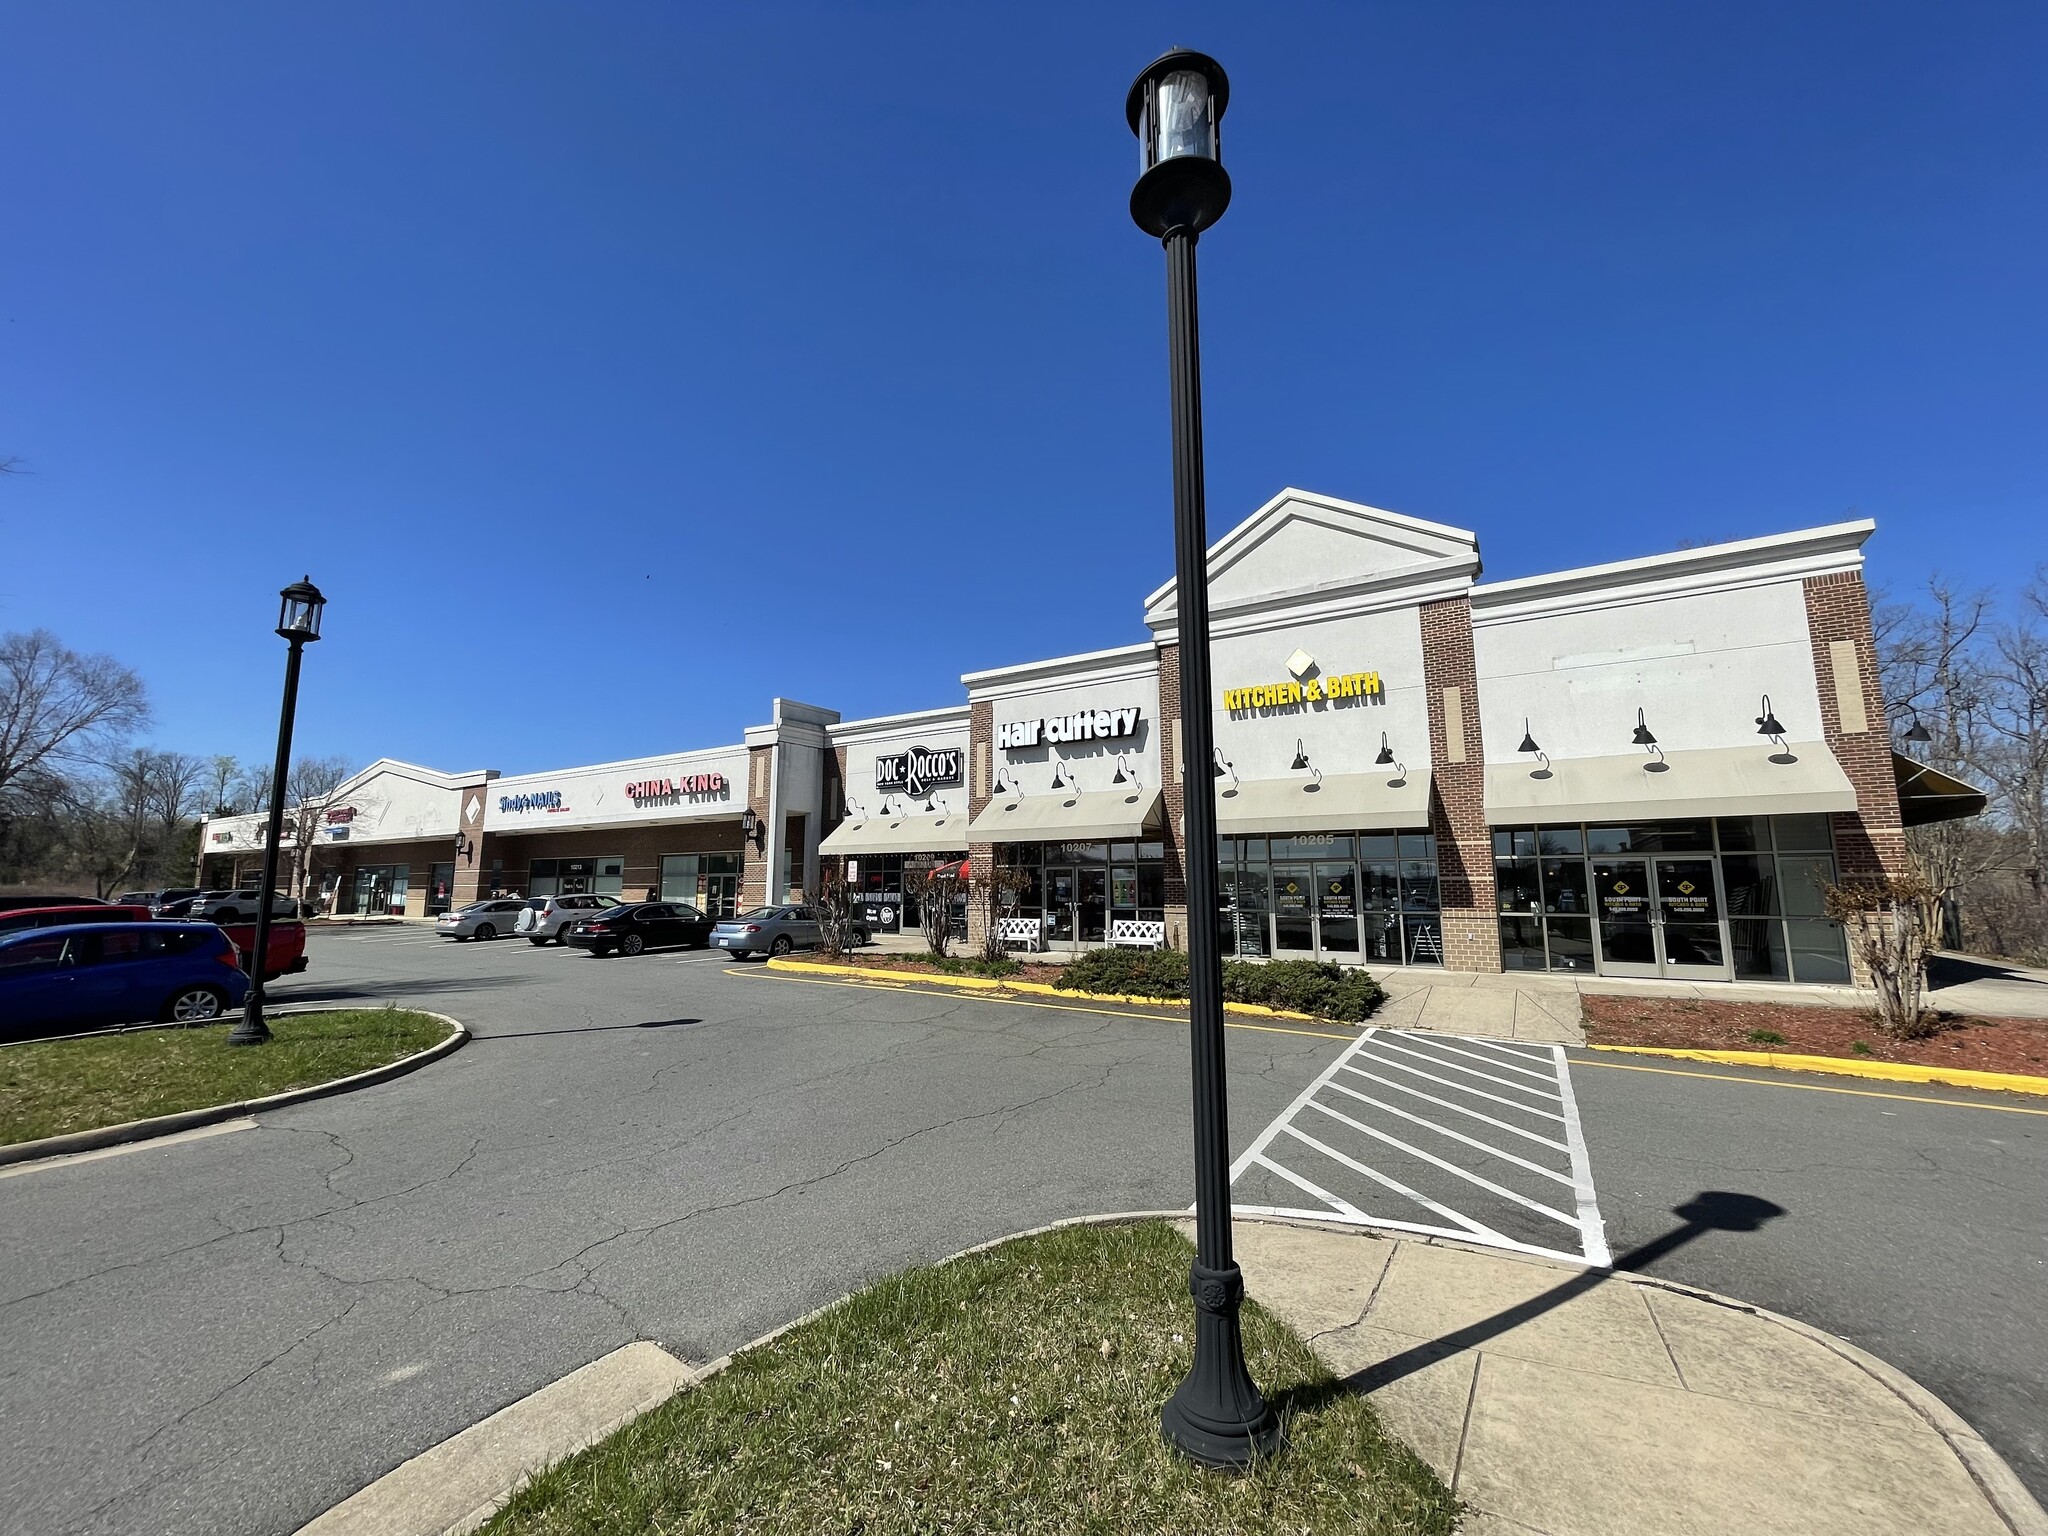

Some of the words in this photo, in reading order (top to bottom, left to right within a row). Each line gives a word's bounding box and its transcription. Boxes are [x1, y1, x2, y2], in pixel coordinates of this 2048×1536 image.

[1224, 681, 1302, 711] KITCHEN
[1306, 678, 1322, 702] &
[1327, 671, 1381, 699] BATH
[997, 719, 1044, 750] Hair
[625, 778, 673, 799] CHINA
[680, 772, 724, 793] KING
[877, 758, 899, 783] DOC
[905, 750, 957, 794] ROCCO'S
[1061, 842, 1092, 853] 10207
[1292, 834, 1335, 846] 10205
